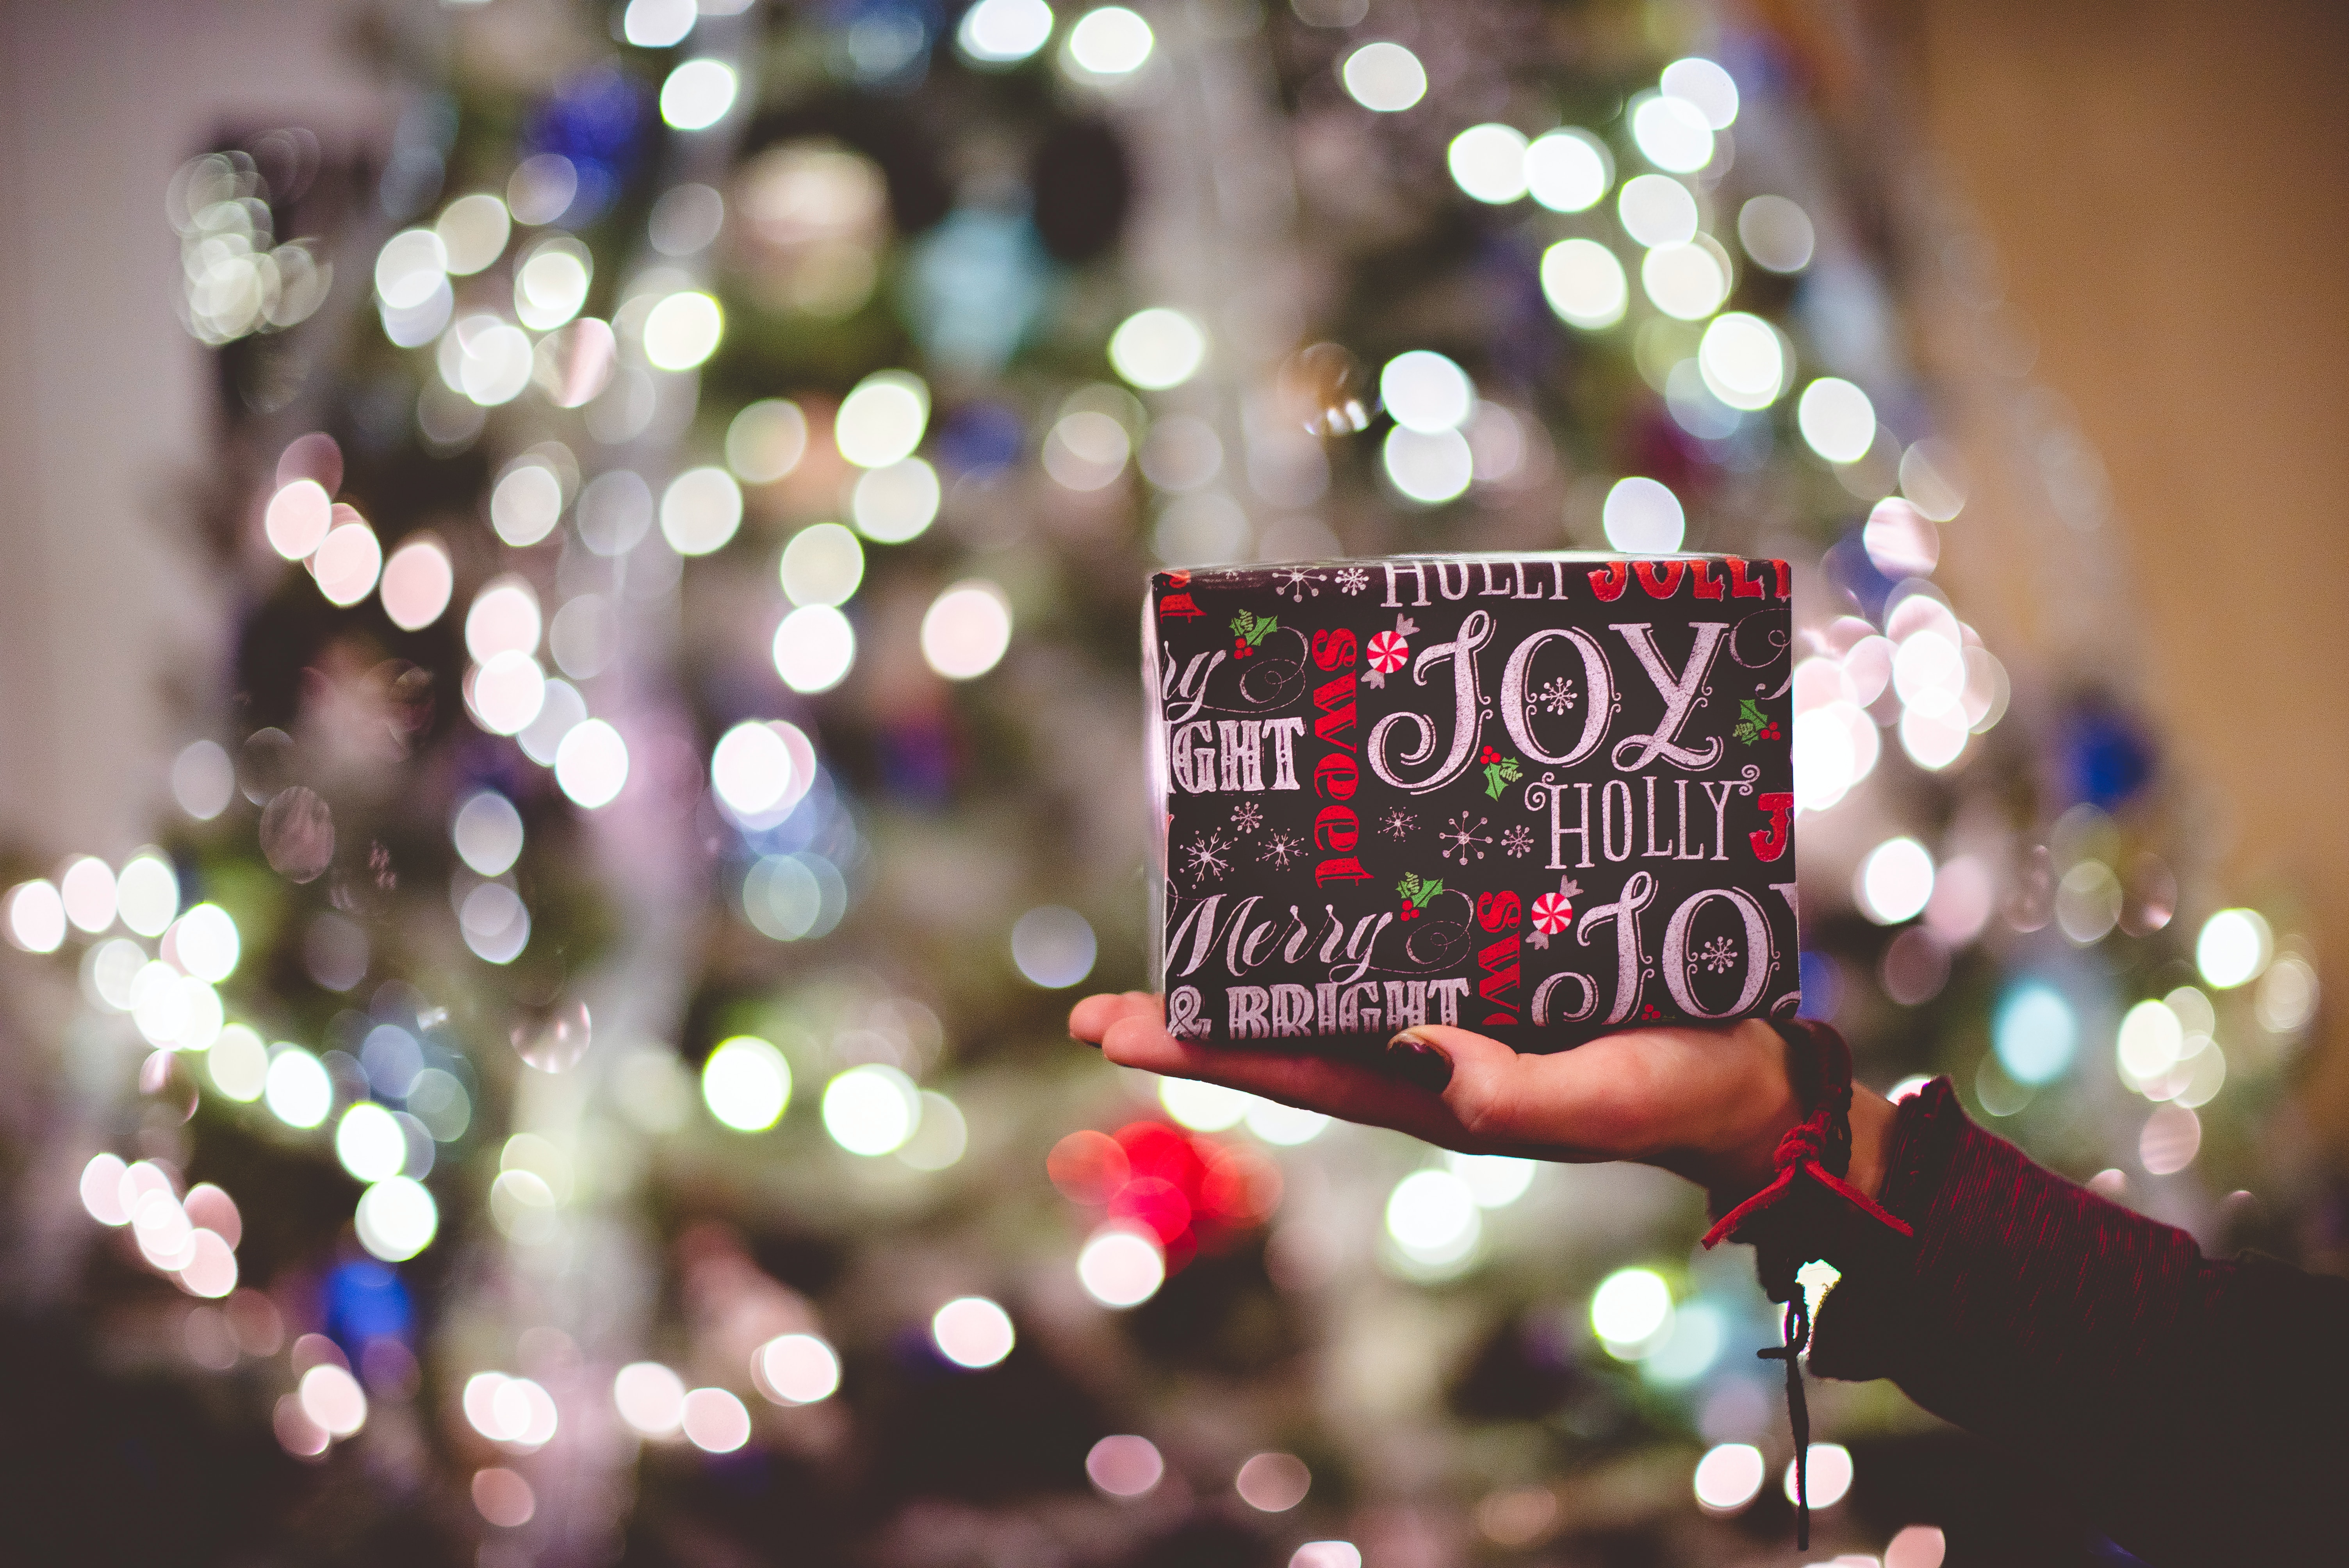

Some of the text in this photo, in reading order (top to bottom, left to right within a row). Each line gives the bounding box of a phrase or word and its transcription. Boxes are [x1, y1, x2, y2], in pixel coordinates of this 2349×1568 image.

[1368, 610, 1731, 796] JOY
[1524, 764, 1760, 870] HOLLY
[1165, 893, 1394, 985] Merry
[1167, 977, 1471, 1040] & BRIGHT
